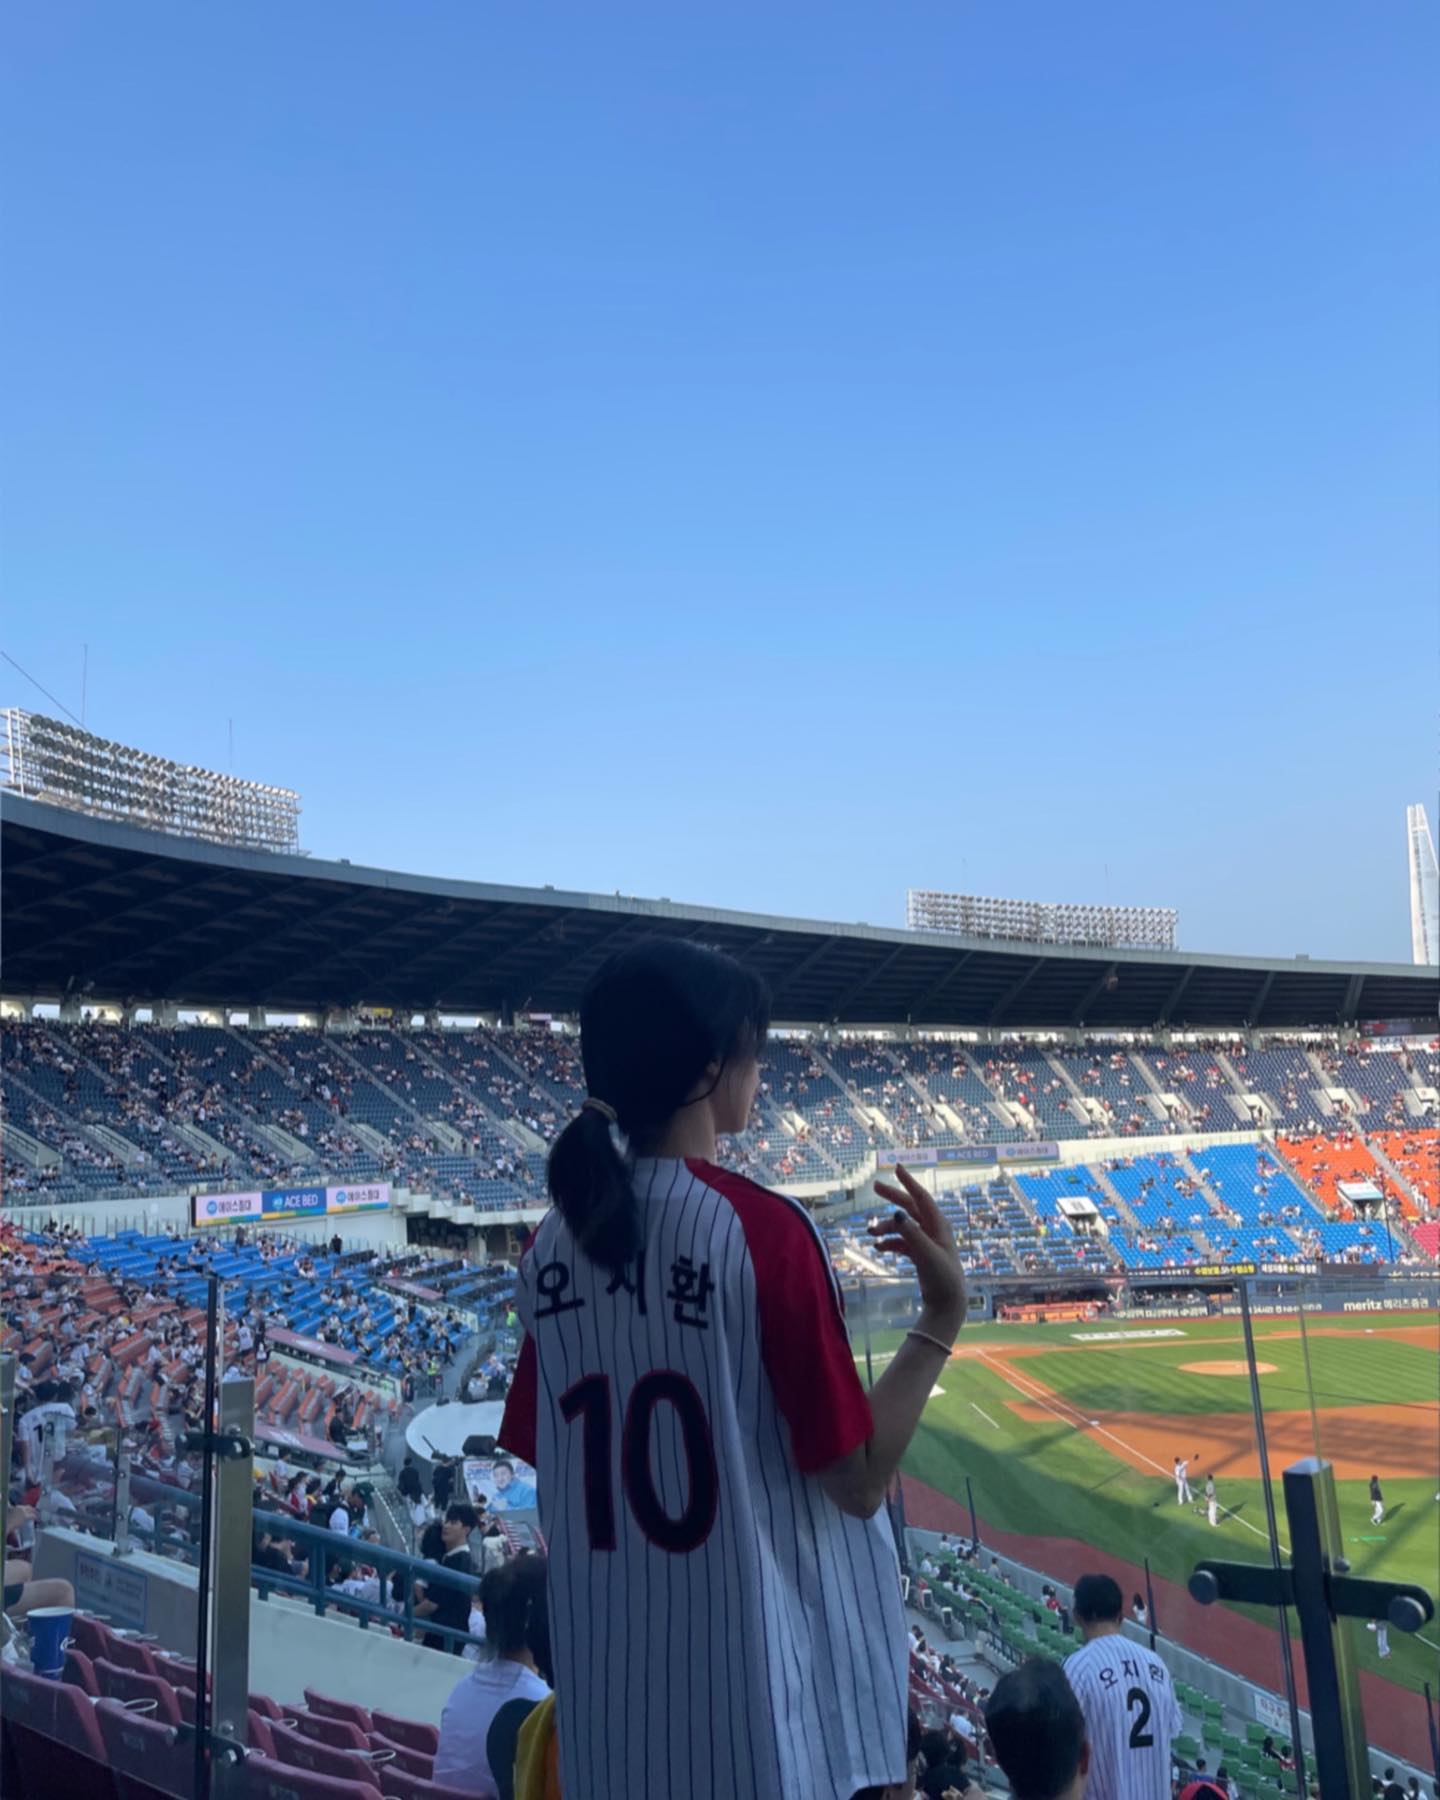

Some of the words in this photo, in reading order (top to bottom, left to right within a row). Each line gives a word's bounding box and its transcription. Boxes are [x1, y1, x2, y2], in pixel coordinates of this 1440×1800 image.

[284, 1195, 301, 1208] ACE
[302, 1193, 319, 1207] BED
[1343, 1298, 1382, 1312] meritz
[558, 1368, 719, 1553] 10
[1127, 1687, 1154, 1749] 2
